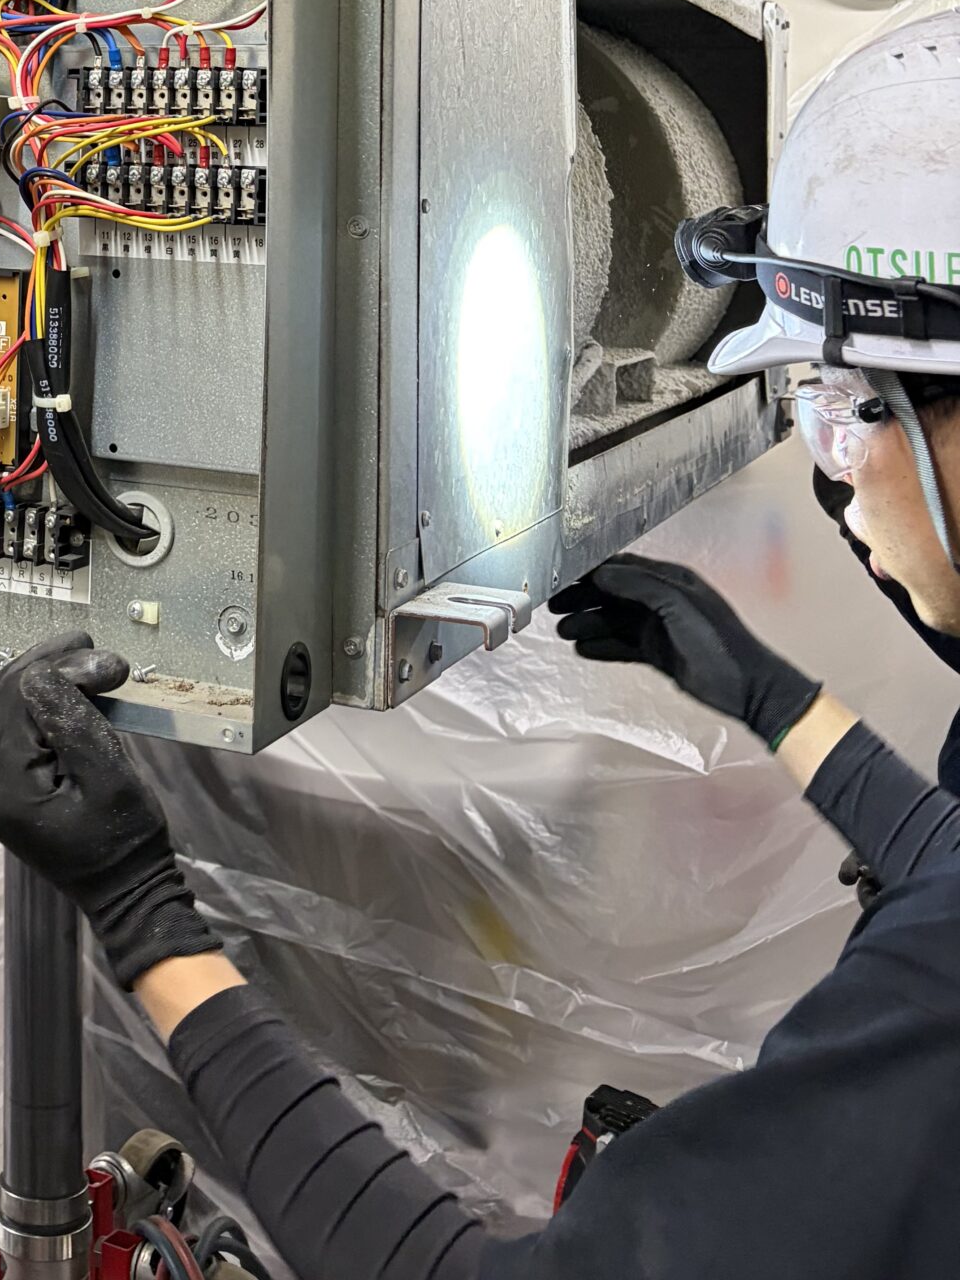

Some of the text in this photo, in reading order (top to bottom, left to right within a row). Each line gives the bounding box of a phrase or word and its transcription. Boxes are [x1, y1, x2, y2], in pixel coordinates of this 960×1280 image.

[233, 139, 242, 148] 27
[255, 139, 264, 149] 28
[102, 231, 263, 247] 11 12 13 14 15 16 17 18
[0, 566, 5, 575] 3
[18, 570, 45, 581] R S
